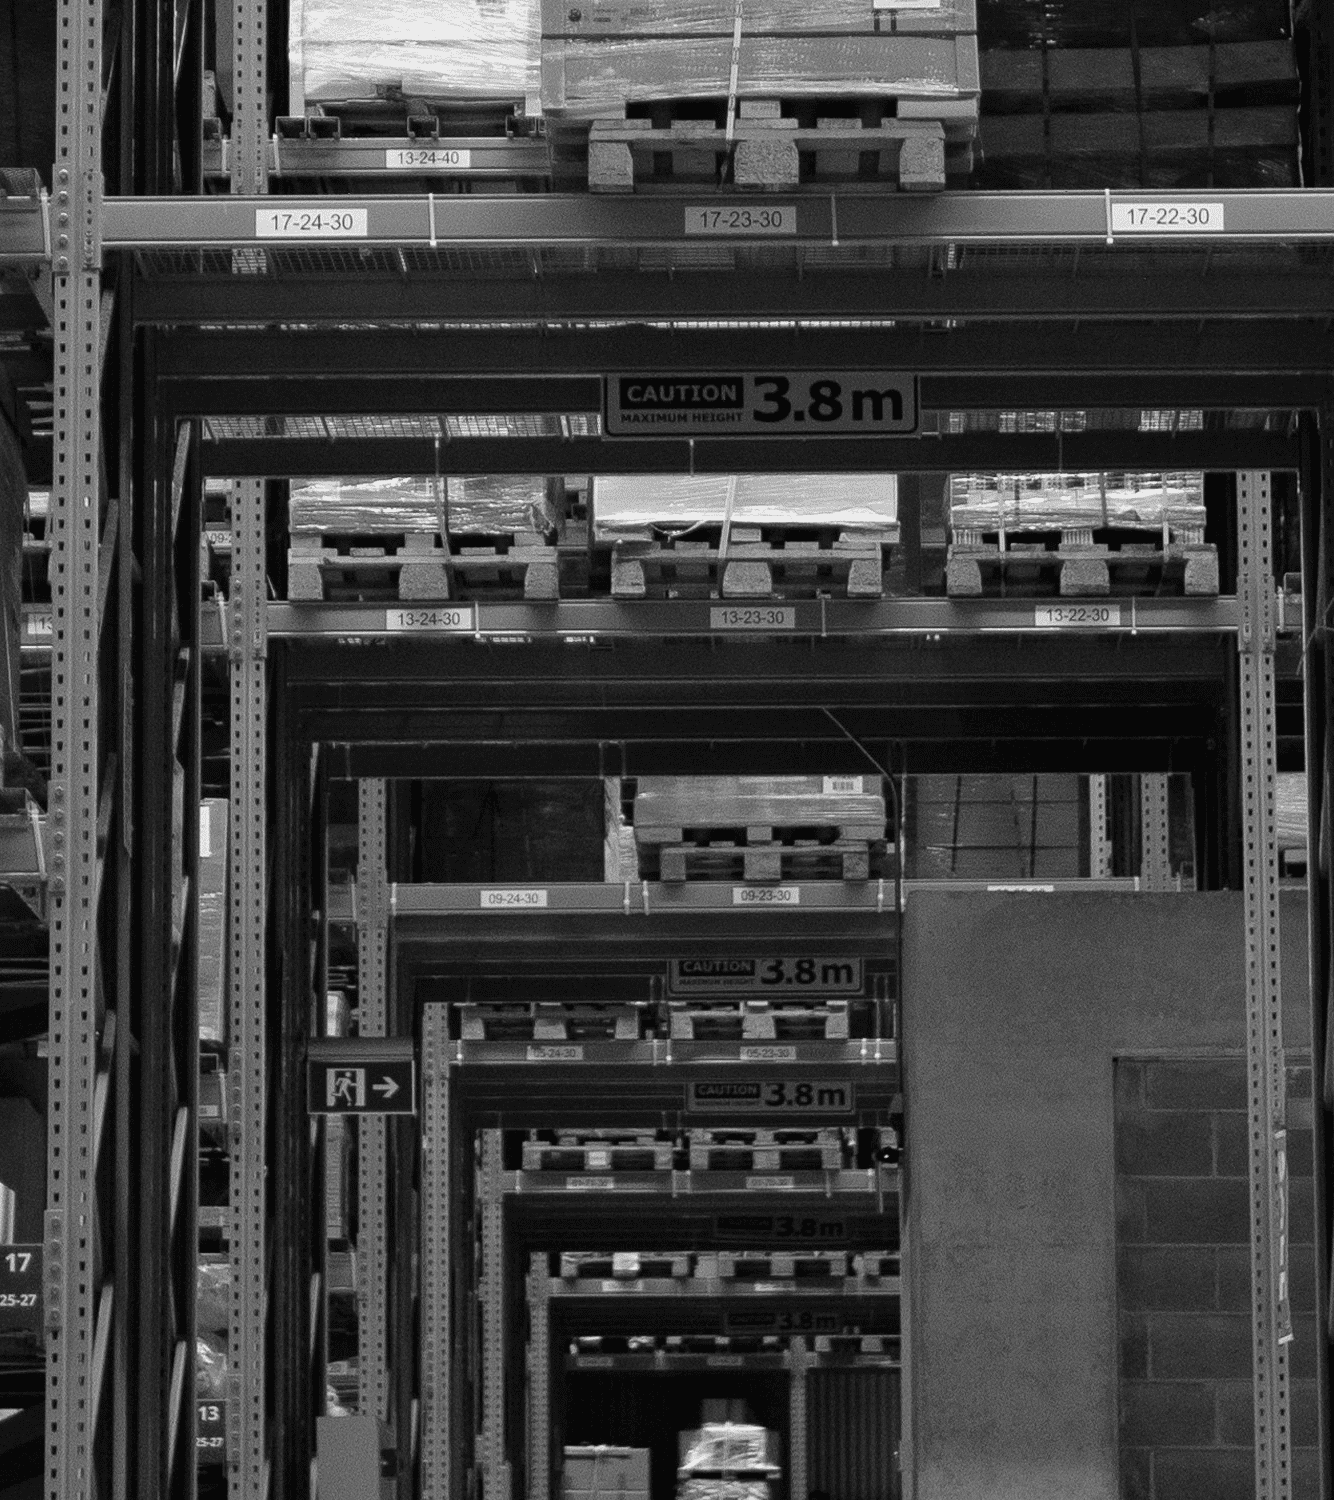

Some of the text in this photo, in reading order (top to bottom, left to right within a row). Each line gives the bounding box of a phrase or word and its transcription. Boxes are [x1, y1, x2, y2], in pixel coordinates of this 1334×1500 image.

[398, 150, 460, 165] 13-24-40
[271, 213, 354, 231] 17-24-30
[699, 210, 783, 228] 17-23-30
[1126, 207, 1210, 225] 17-22-30
[626, 384, 738, 403] CAUTION
[620, 411, 744, 423] MAXIMUM HEIGHT
[398, 612, 461, 626] 13-24-30
[721, 610, 785, 625] 13-23-30
[1046, 607, 1110, 622] 13-22-30
[488, 892, 539, 904] 09-24-30
[740, 889, 791, 902] 09-23-30
[681, 960, 753, 973] CAUTION
[697, 1084, 758, 1096] CAUTION
[4, 1252, 32, 1273] 17
[197, 1405, 220, 1421] 13
